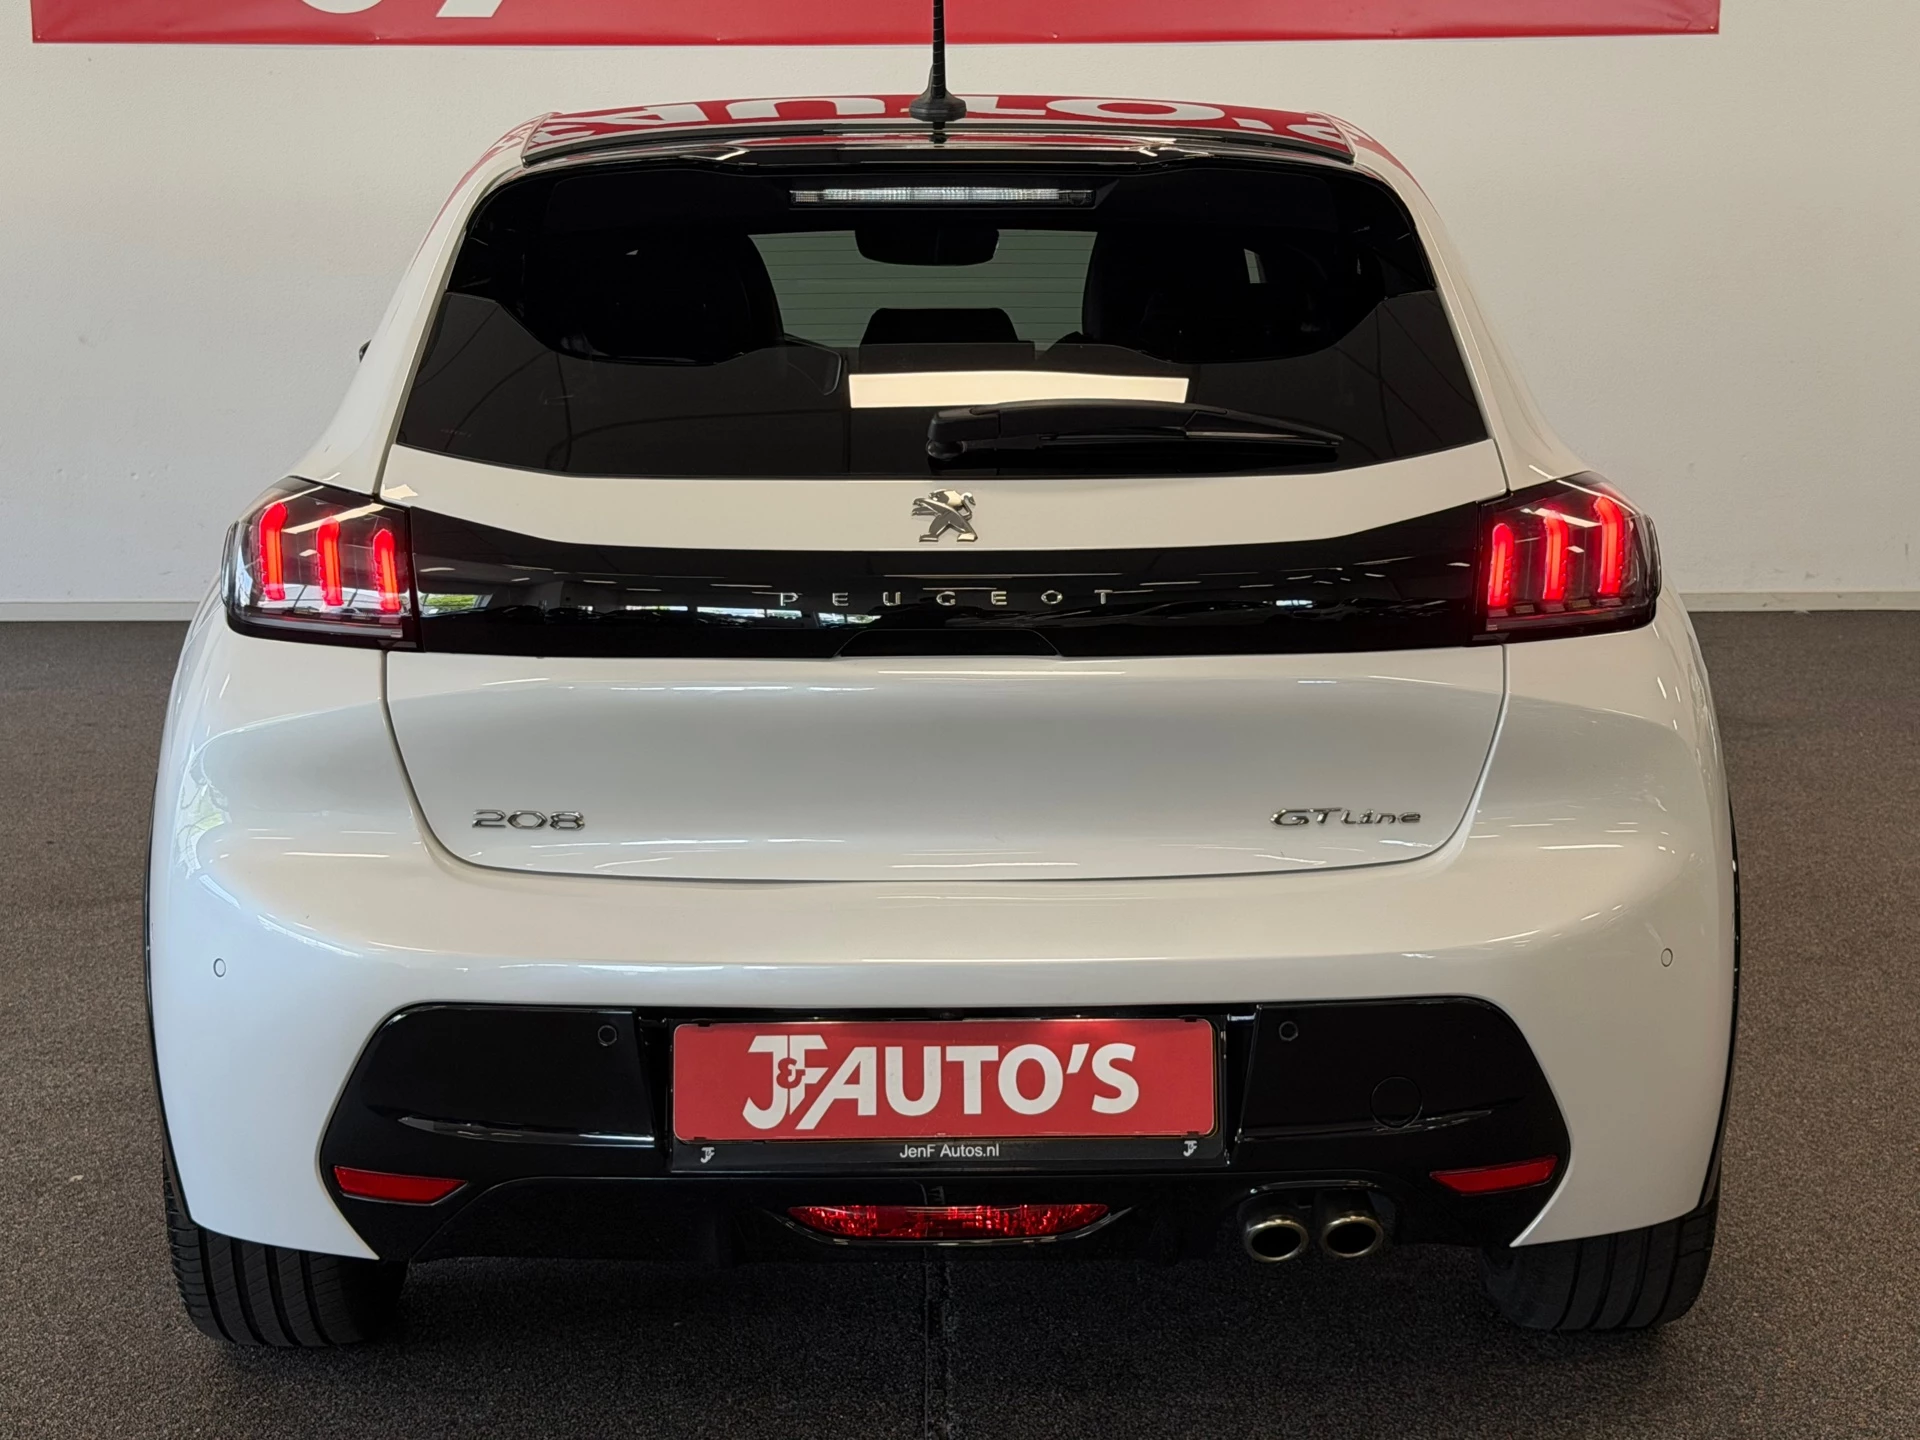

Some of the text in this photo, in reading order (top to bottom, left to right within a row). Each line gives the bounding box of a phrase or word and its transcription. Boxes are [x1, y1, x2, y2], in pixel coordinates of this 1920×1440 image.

[780, 589, 1113, 607] PEUGEOT
[471, 809, 586, 831] 208
[899, 1143, 999, 1158] JenF Autos.nl
